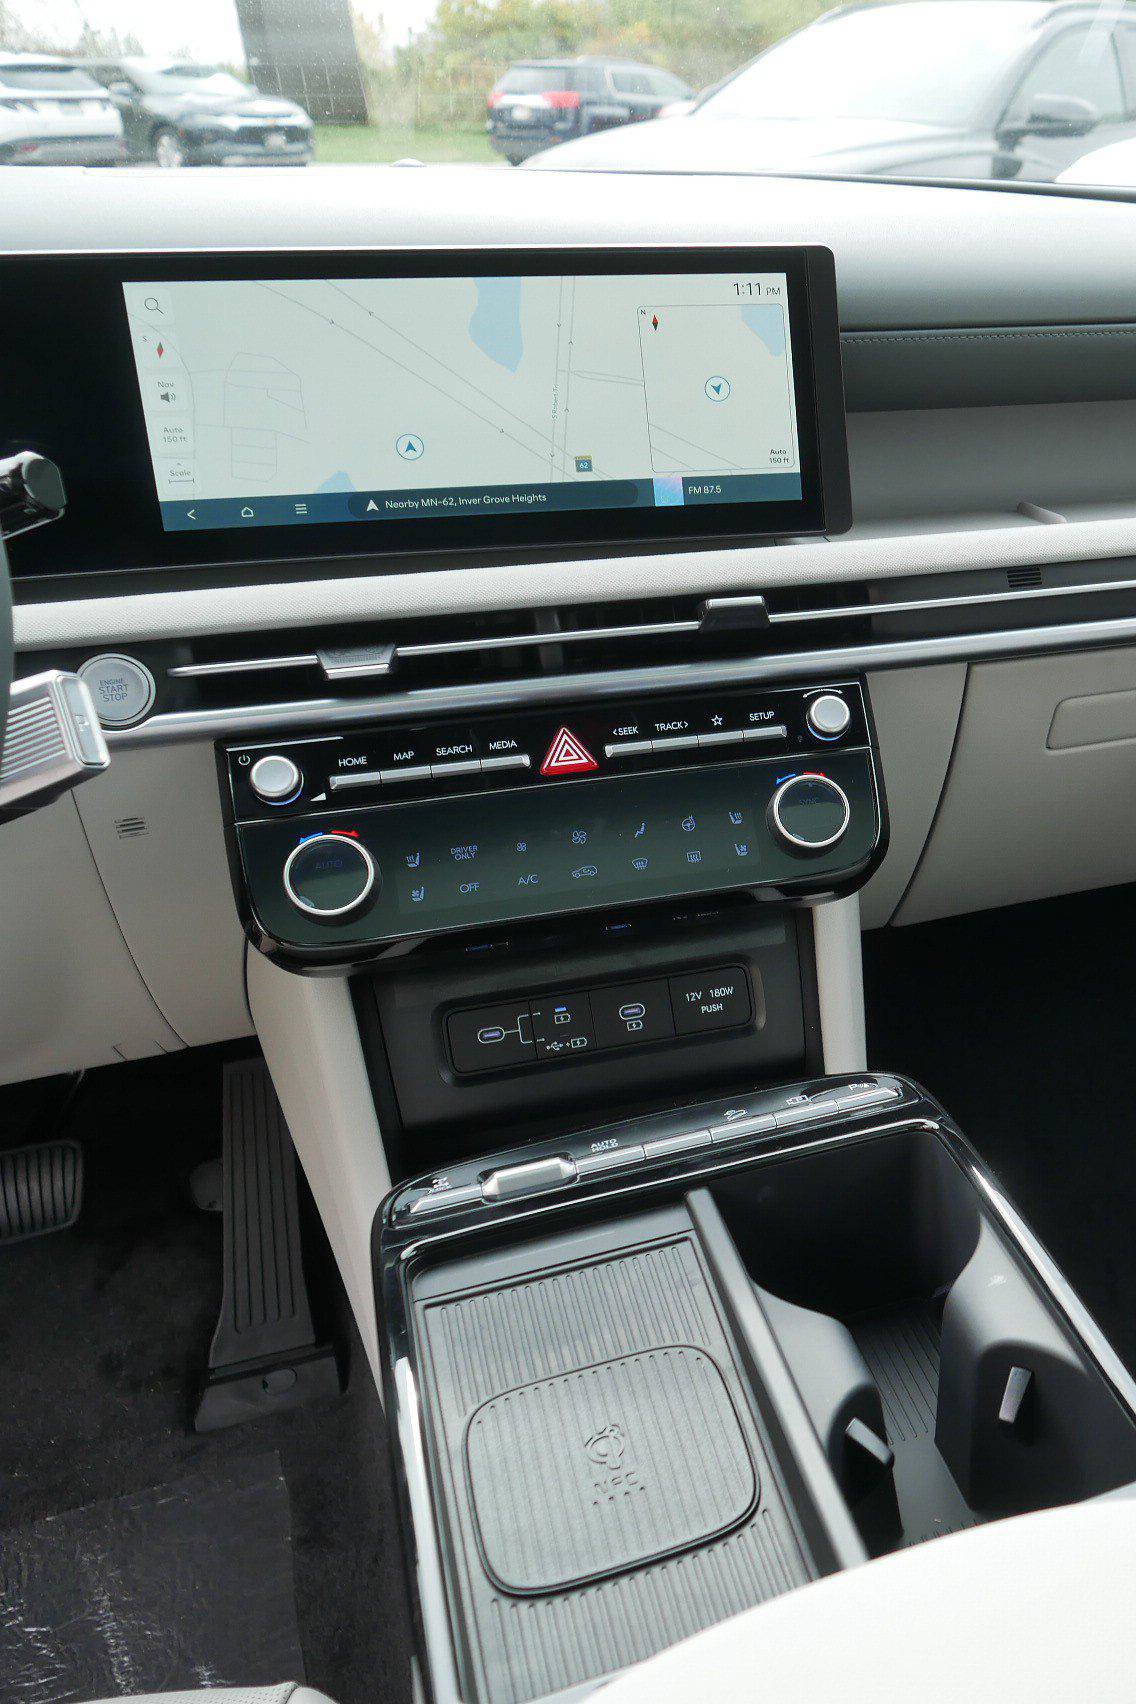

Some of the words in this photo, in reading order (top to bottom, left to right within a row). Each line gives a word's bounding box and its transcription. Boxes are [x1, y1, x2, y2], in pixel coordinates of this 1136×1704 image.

[733, 282, 761, 295] 1:11
[766, 287, 781, 296] PM
[157, 380, 174, 388] Nav
[163, 425, 184, 434] Auto
[163, 435, 179, 443] 150
[769, 456, 782, 464] 150
[169, 469, 191, 477] Scale
[688, 486, 702, 495] FM
[703, 484, 722, 495] 87.5
[385, 499, 420, 510] Nearby
[421, 497, 457, 508] MN-62,
[458, 496, 483, 506] Inver
[483, 494, 511, 504] Grove
[511, 492, 547, 504] Heights
[98, 684, 128, 695] START
[102, 692, 128, 702] STOP
[749, 711, 775, 721] SETUP
[435, 744, 473, 756] SEARCH
[488, 739, 518, 750] MEDIA
[393, 750, 415, 761] MAP
[338, 756, 367, 767] HOME
[450, 844, 478, 855] DRIVER
[454, 852, 476, 861] ONLY
[517, 874, 540, 886] A/C
[459, 881, 480, 893] OFF
[685, 990, 702, 1001] 12V
[709, 986, 734, 998] 180W
[701, 1003, 723, 1014] PUSH
